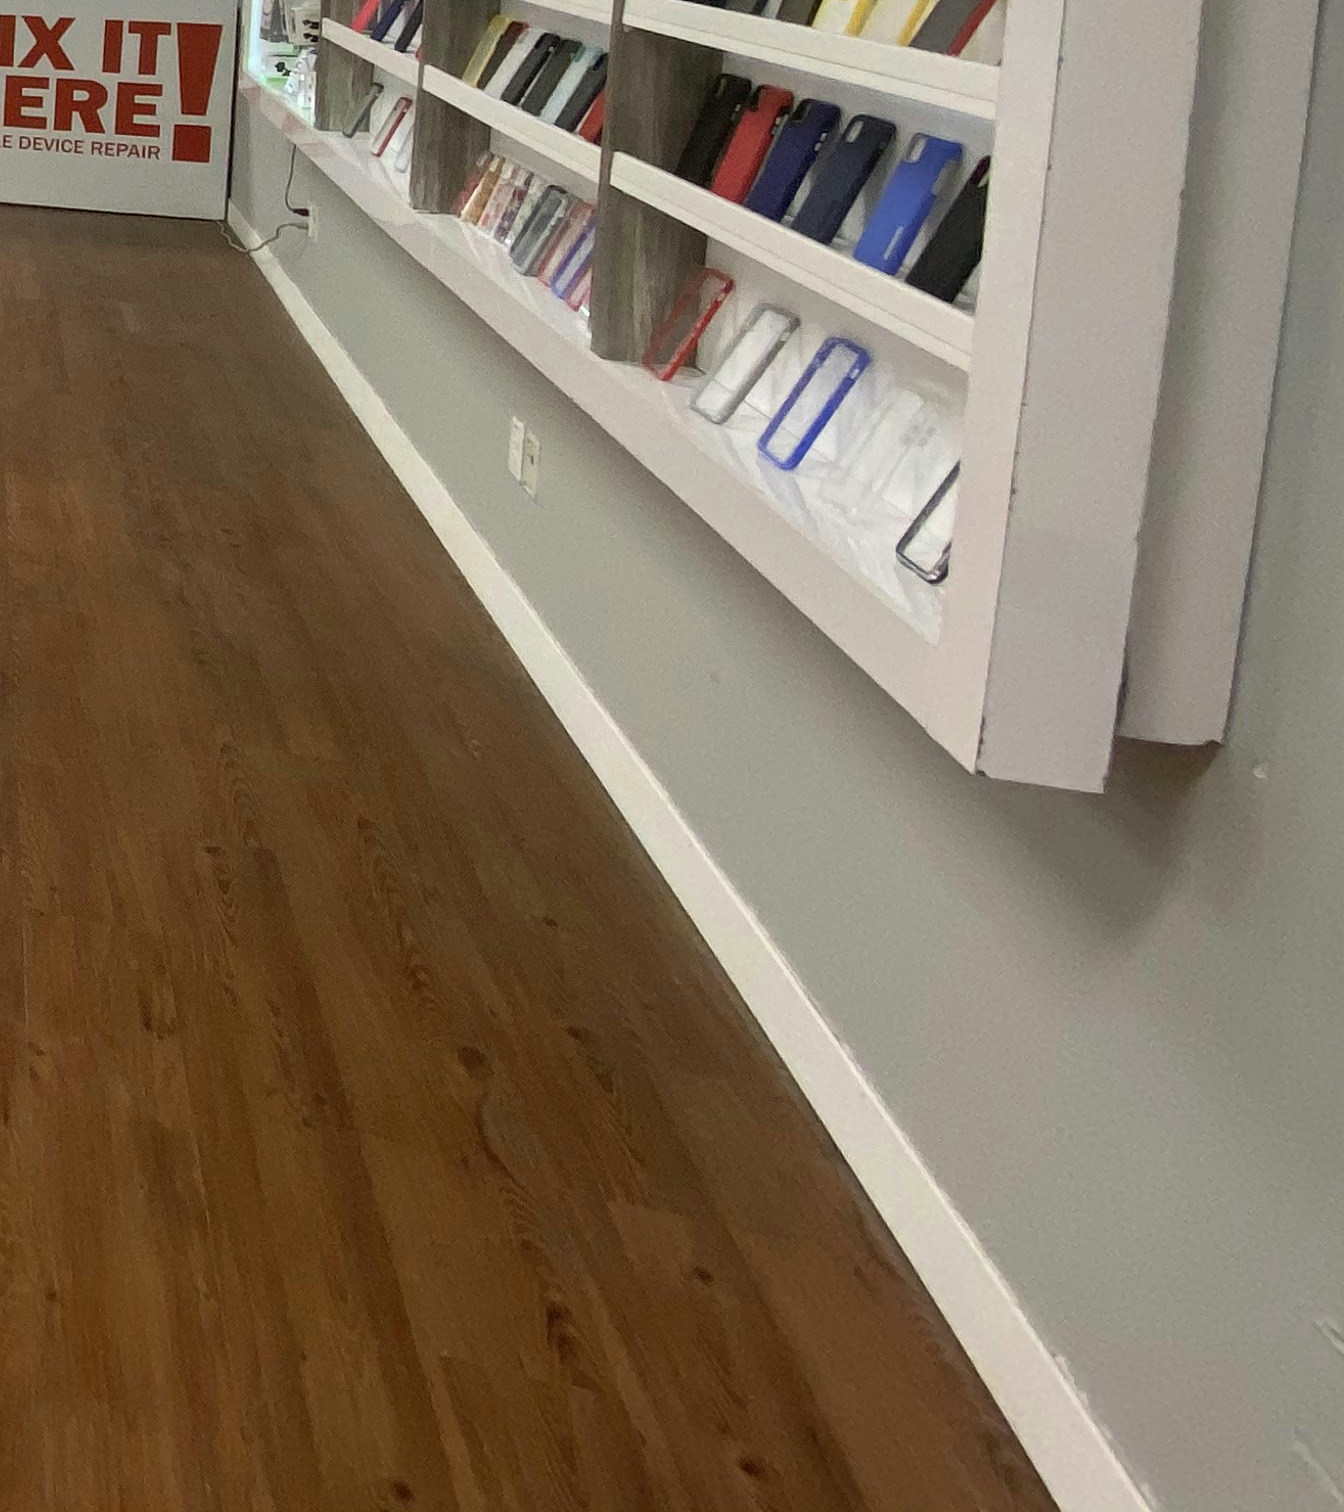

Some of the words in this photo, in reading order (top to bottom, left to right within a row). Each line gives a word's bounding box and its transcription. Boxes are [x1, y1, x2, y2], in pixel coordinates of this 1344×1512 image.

[102, 18, 172, 76] IT
[18, 135, 85, 155] DEVICE
[90, 140, 161, 161] REPAIR
